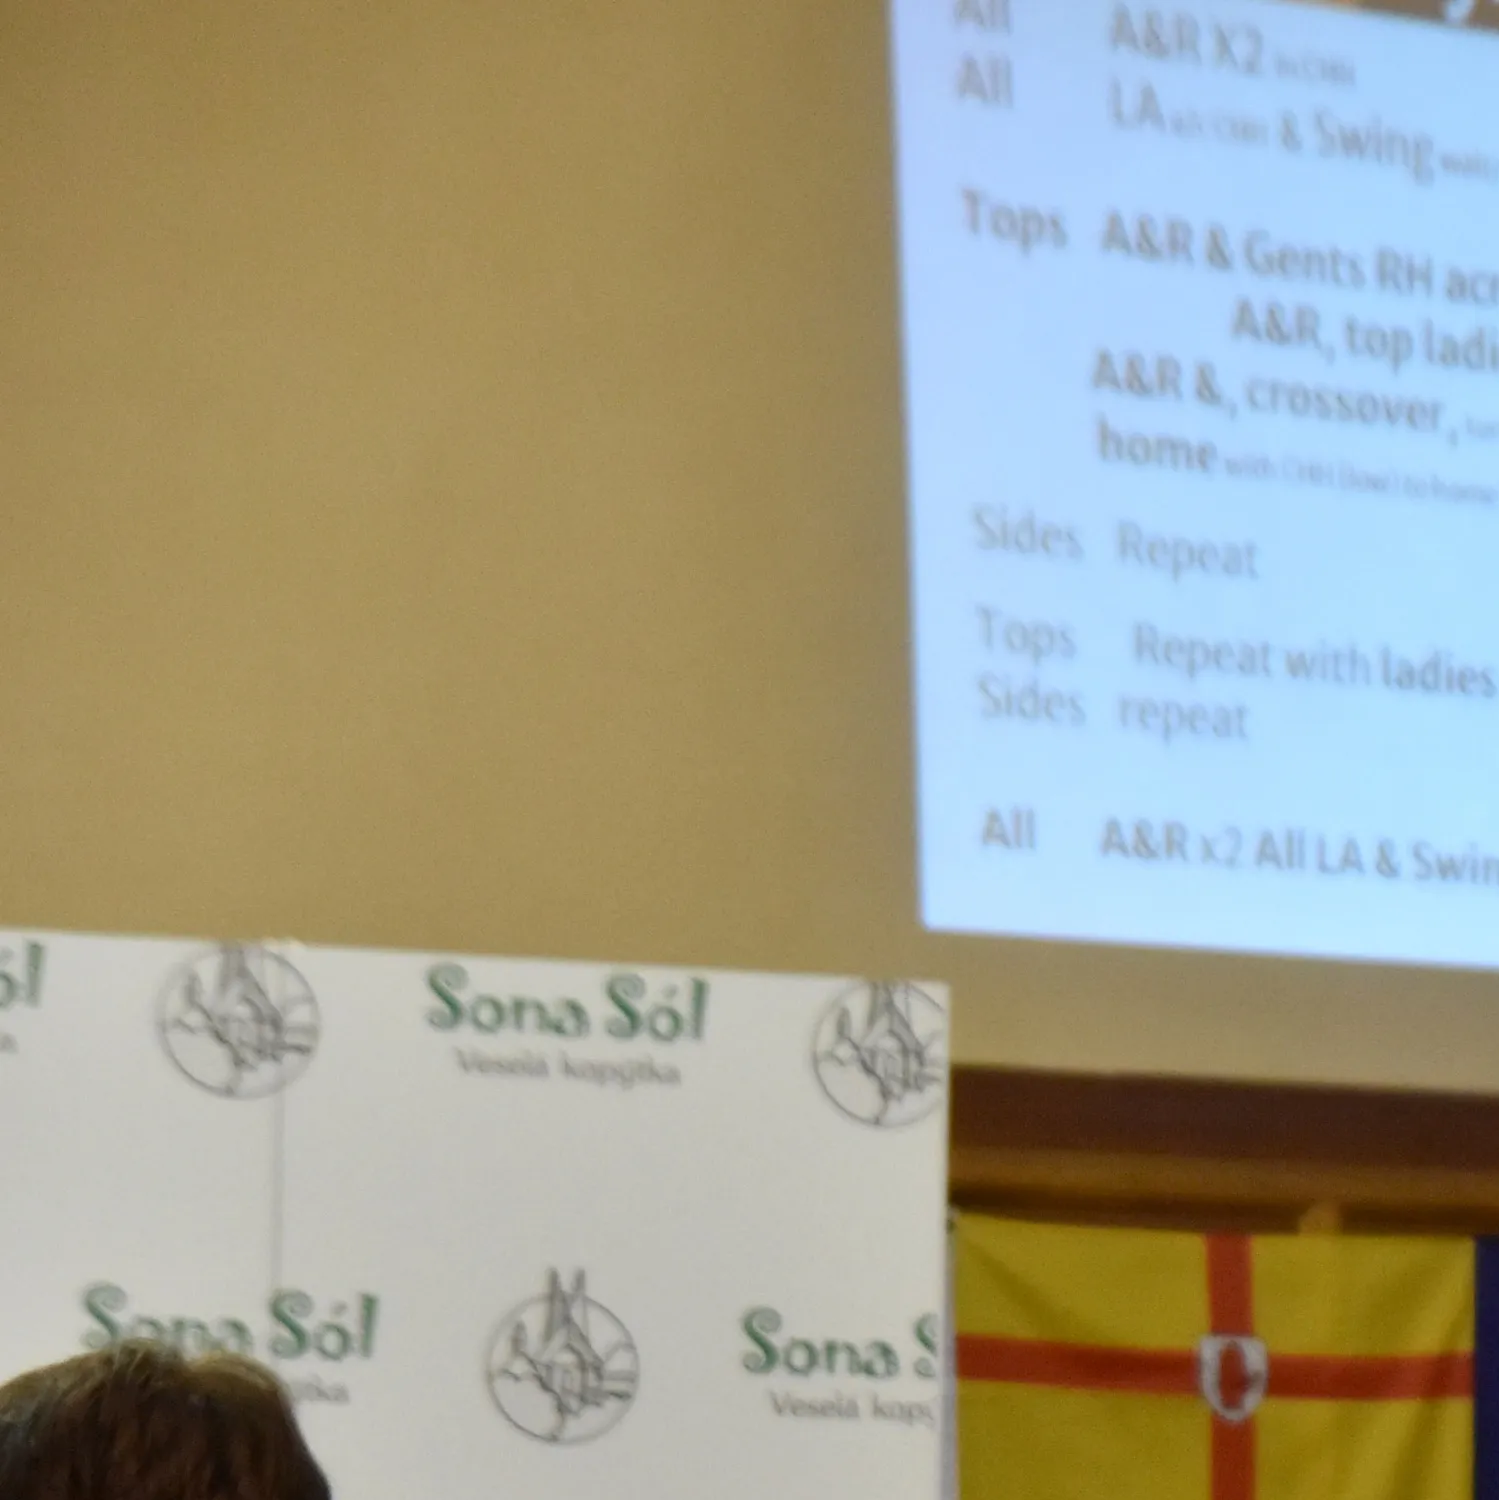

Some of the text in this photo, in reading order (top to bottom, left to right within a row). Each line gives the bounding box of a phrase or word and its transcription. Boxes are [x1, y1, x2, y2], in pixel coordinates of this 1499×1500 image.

[1109, 6, 1199, 60] A&R
[1214, 24, 1264, 76] X2
[956, 55, 1013, 109] All
[1109, 79, 1166, 135] LA
[1279, 110, 1304, 153] &
[1313, 107, 1434, 186] Swing
[961, 187, 1068, 257] Tops
[1100, 208, 1195, 265] A&R
[1205, 224, 1233, 271] &
[1243, 229, 1366, 290] Gents
[1375, 246, 1433, 299] RH
[1231, 296, 1334, 364] A&R,
[1344, 311, 1414, 375] top
[1093, 347, 1184, 402] A&R
[1095, 411, 1218, 474] home
[973, 504, 1258, 582] Sides Repeat
[977, 605, 1077, 667] Tops
[1134, 621, 1274, 682] Repeat
[1284, 636, 1370, 687] with
[1381, 644, 1497, 700] ladies
[978, 672, 1249, 744] Sides repeat
[981, 806, 1036, 851] All
[1100, 817, 1189, 864] A&R
[1201, 827, 1243, 868] x2
[1254, 827, 1305, 873] All
[1315, 832, 1365, 877] LA
[1374, 840, 1400, 881] &
[424, 961, 711, 1042] Sona Sól
[268, 1287, 381, 1361] Sól
[740, 1305, 901, 1380] Sona
